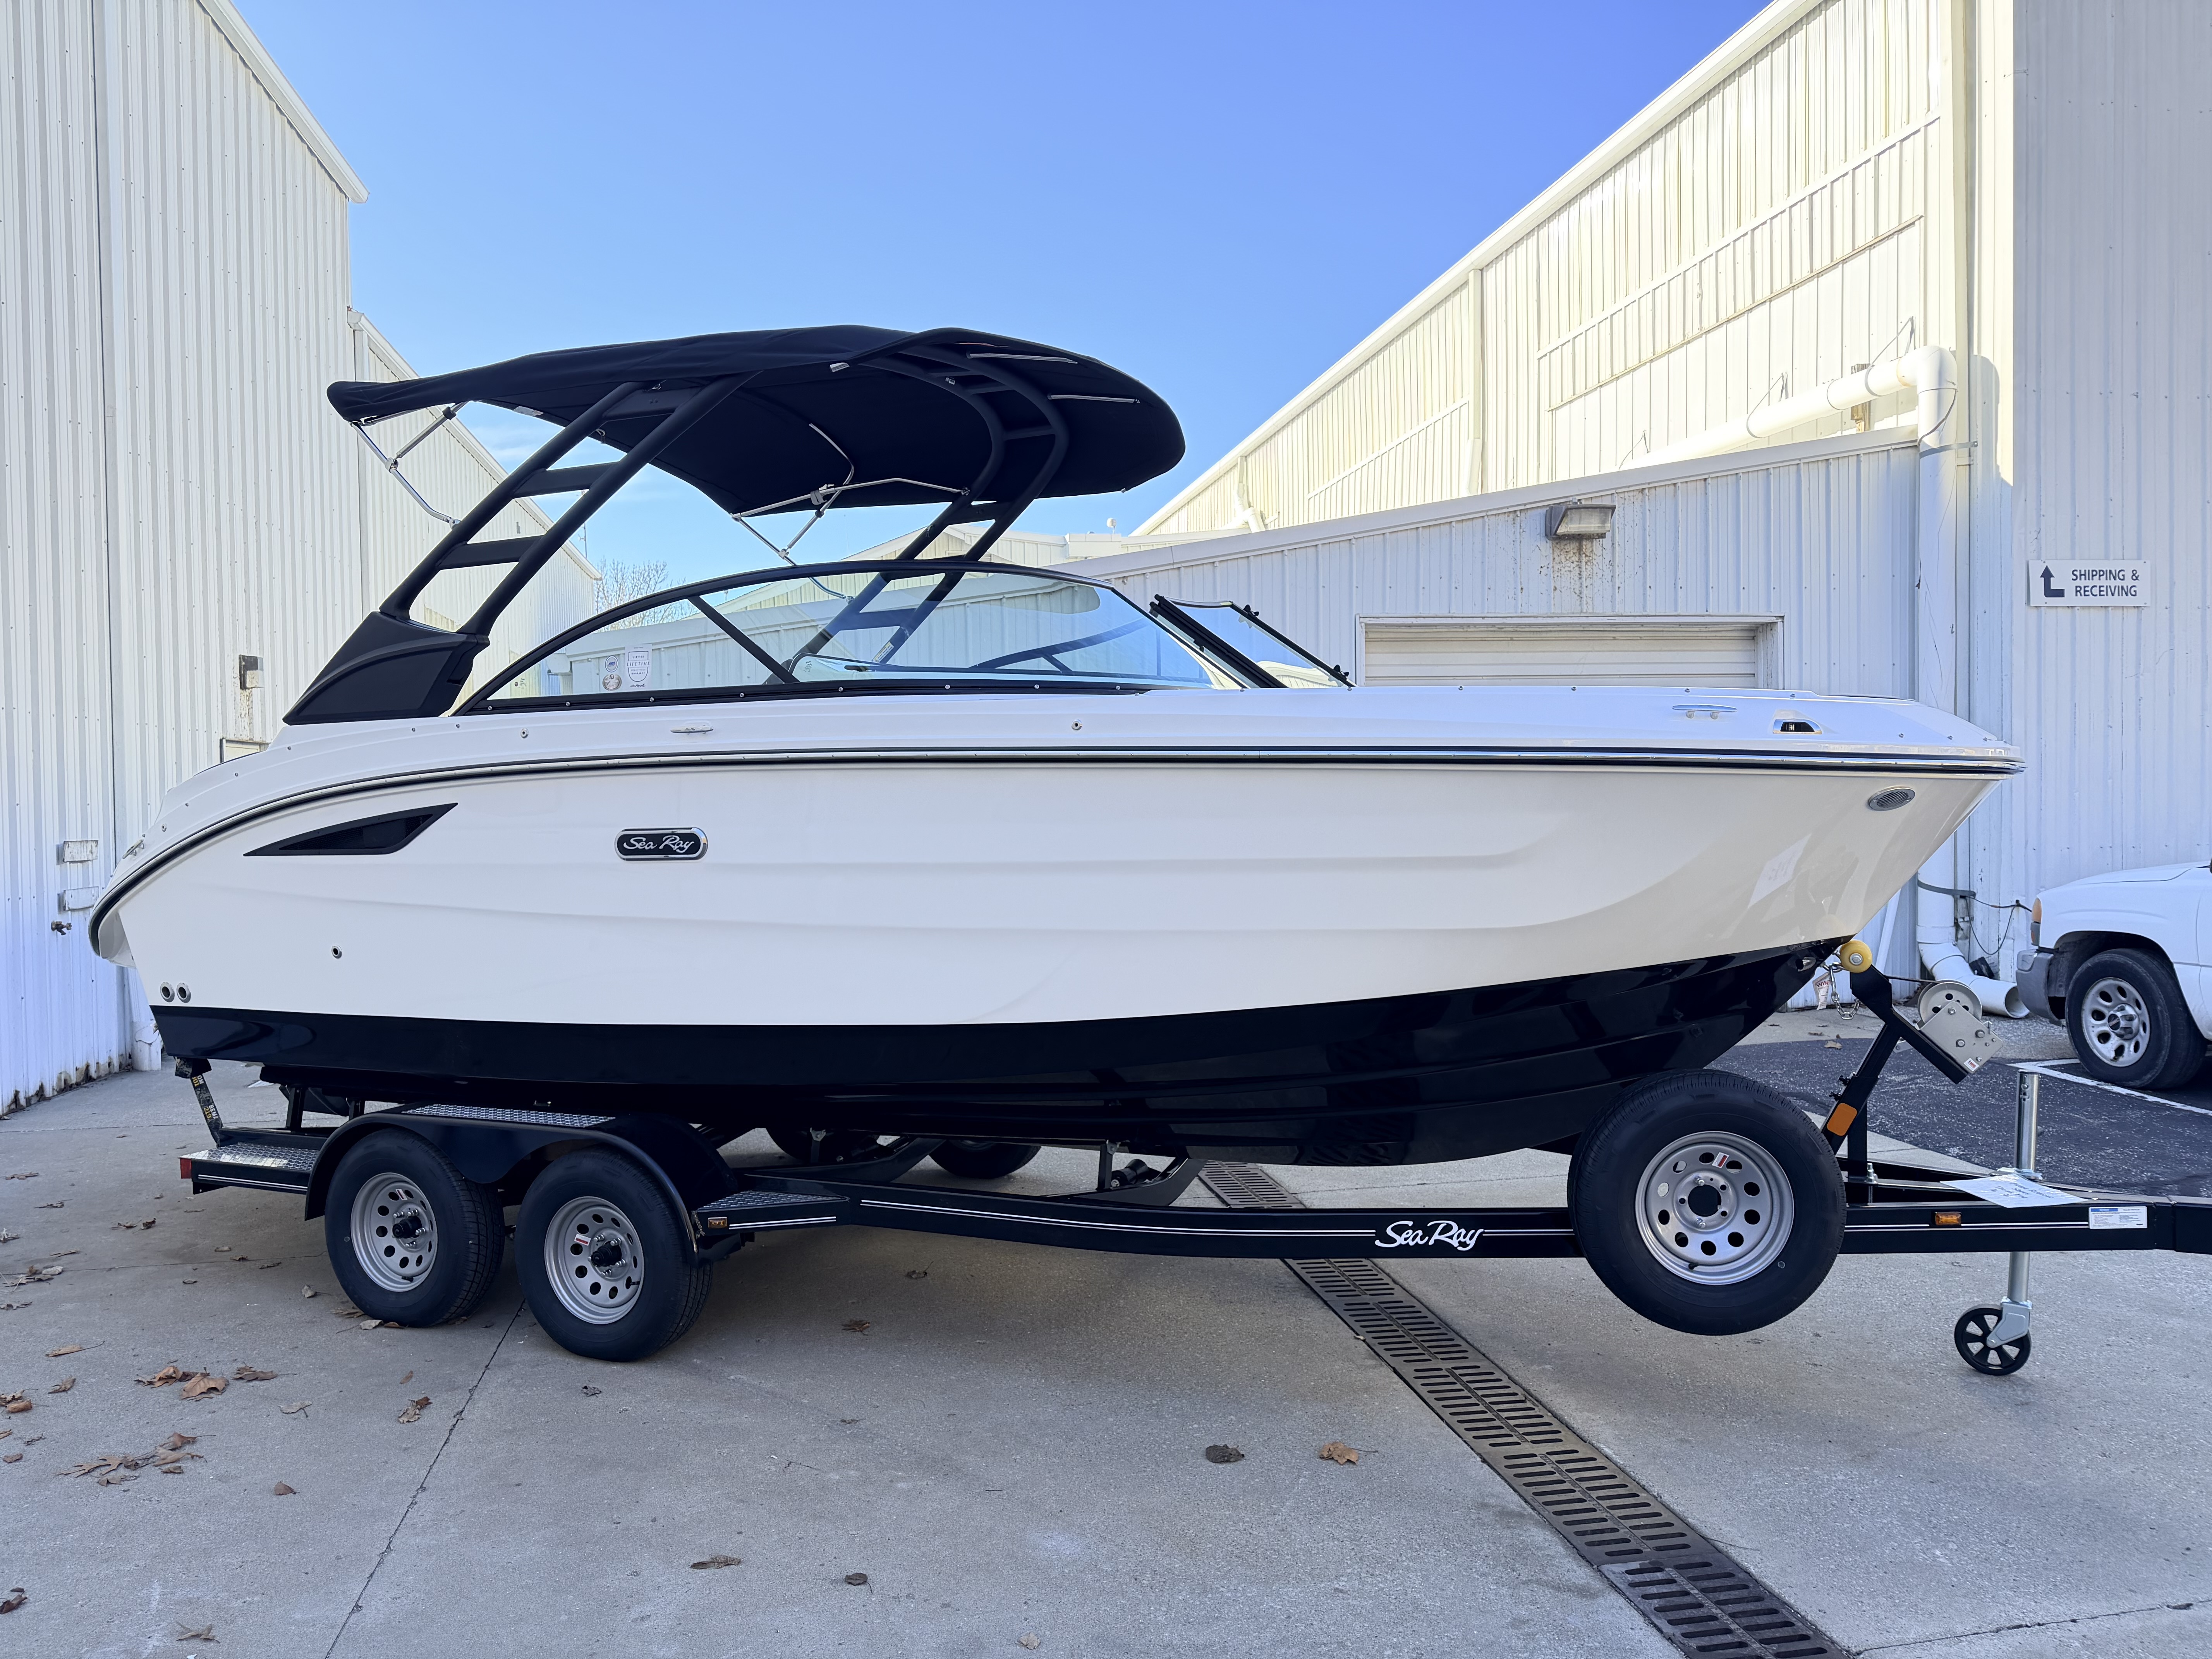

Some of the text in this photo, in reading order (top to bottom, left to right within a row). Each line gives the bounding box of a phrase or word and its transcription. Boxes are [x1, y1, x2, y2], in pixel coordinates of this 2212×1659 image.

[2071, 569, 2140, 581] SHIPPING &
[2075, 585, 2137, 597] RECEIVING
[623, 835, 695, 853] Sea Ray
[204, 1107, 212, 1119] 219
[1375, 1220, 1484, 1251] Sea Ray
